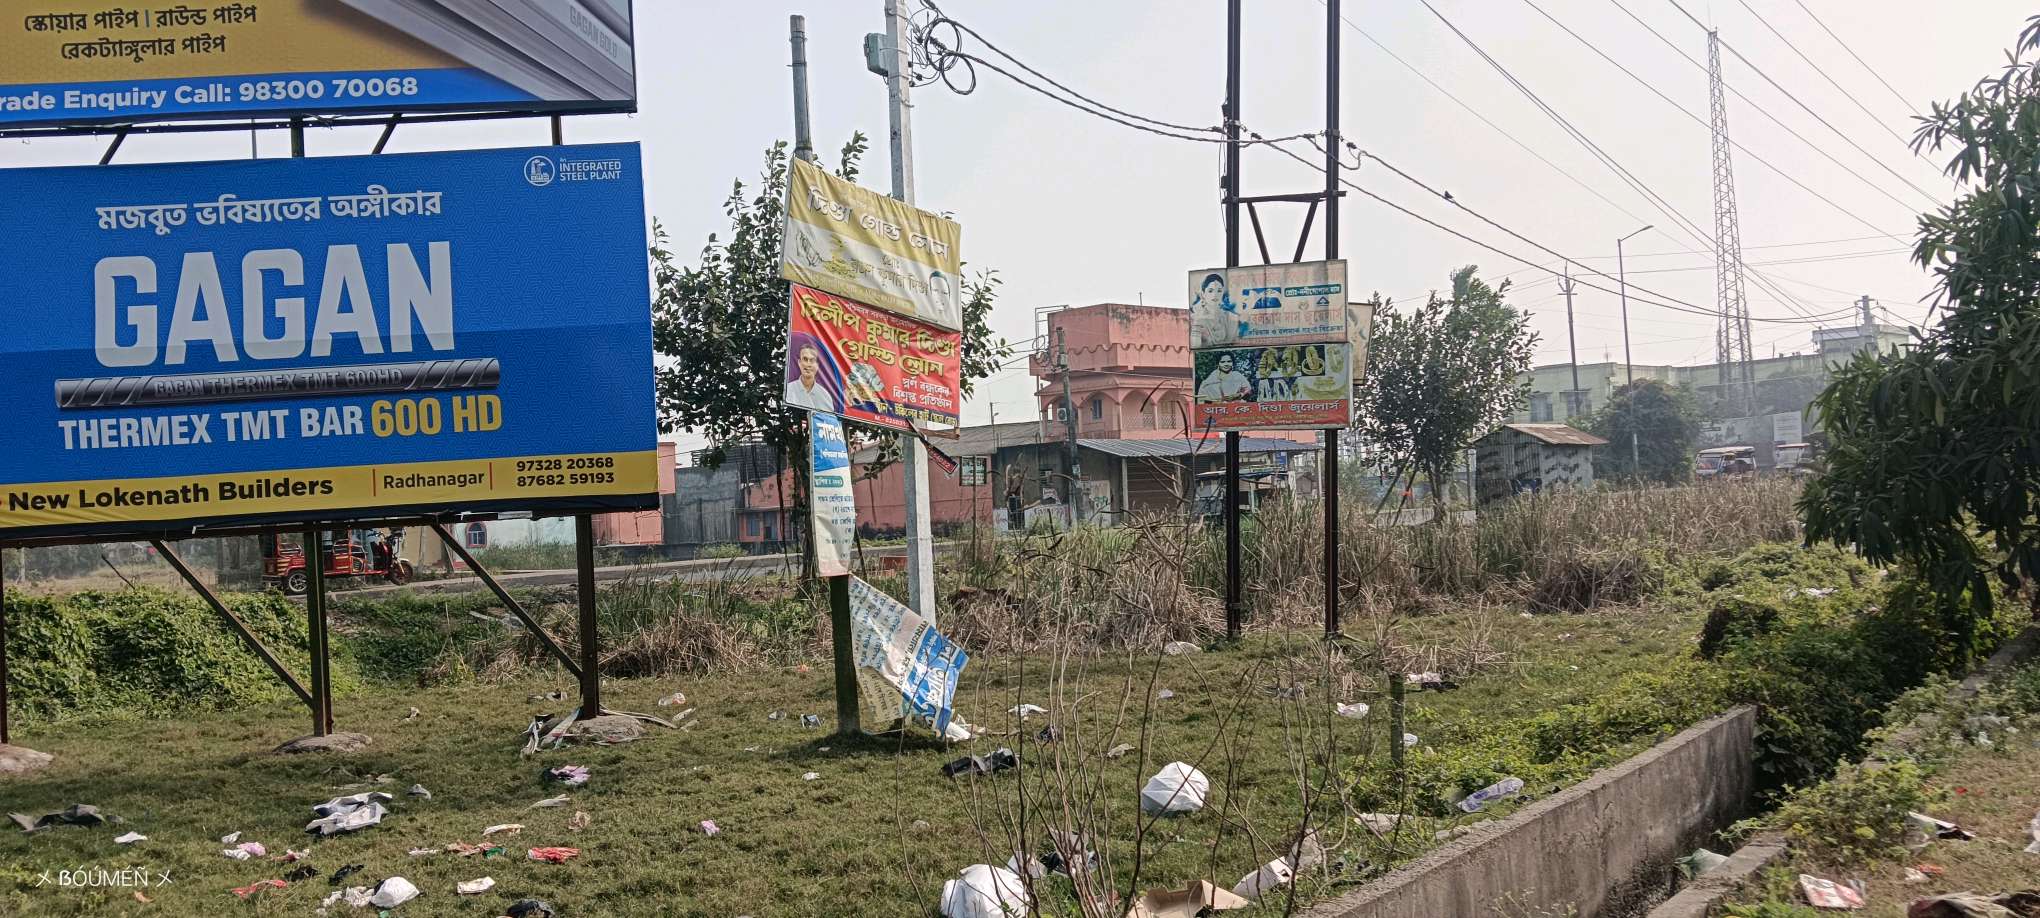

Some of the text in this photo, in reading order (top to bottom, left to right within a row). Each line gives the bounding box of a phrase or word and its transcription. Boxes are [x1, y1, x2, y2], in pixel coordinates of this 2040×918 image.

[24, 3, 257, 33] স্কোয়ার পাইপ রাউন্ড পাইপ
[61, 33, 226, 63] রেকট্যাঙ্গুলার পাইপ
[64, 87, 167, 112] Enquiry
[174, 83, 231, 104] Call:
[239, 80, 324, 101] 98300
[332, 77, 418, 98] 70068
[560, 161, 621, 172] INTEGRATED
[560, 171, 621, 182] STEEL PLANT
[95, 184, 443, 236] মজবুত ভবিষ্যতের অঙ্গীকার
[94, 241, 455, 367] GAGAN
[800, 294, 860, 333] দিলীপ
[867, 319, 912, 349] কুমার
[840, 337, 944, 377] গোল্ড লোন
[154, 368, 403, 396] GAGAN THERMEX TMT 600HD
[58, 394, 502, 450] THERMEX TMT BAR 600 HD
[516, 457, 614, 472] 97328 20368
[516, 472, 615, 487] 87682 59193
[9, 477, 334, 512] New Lokenath Builders
[383, 472, 485, 490] Radhanagar
